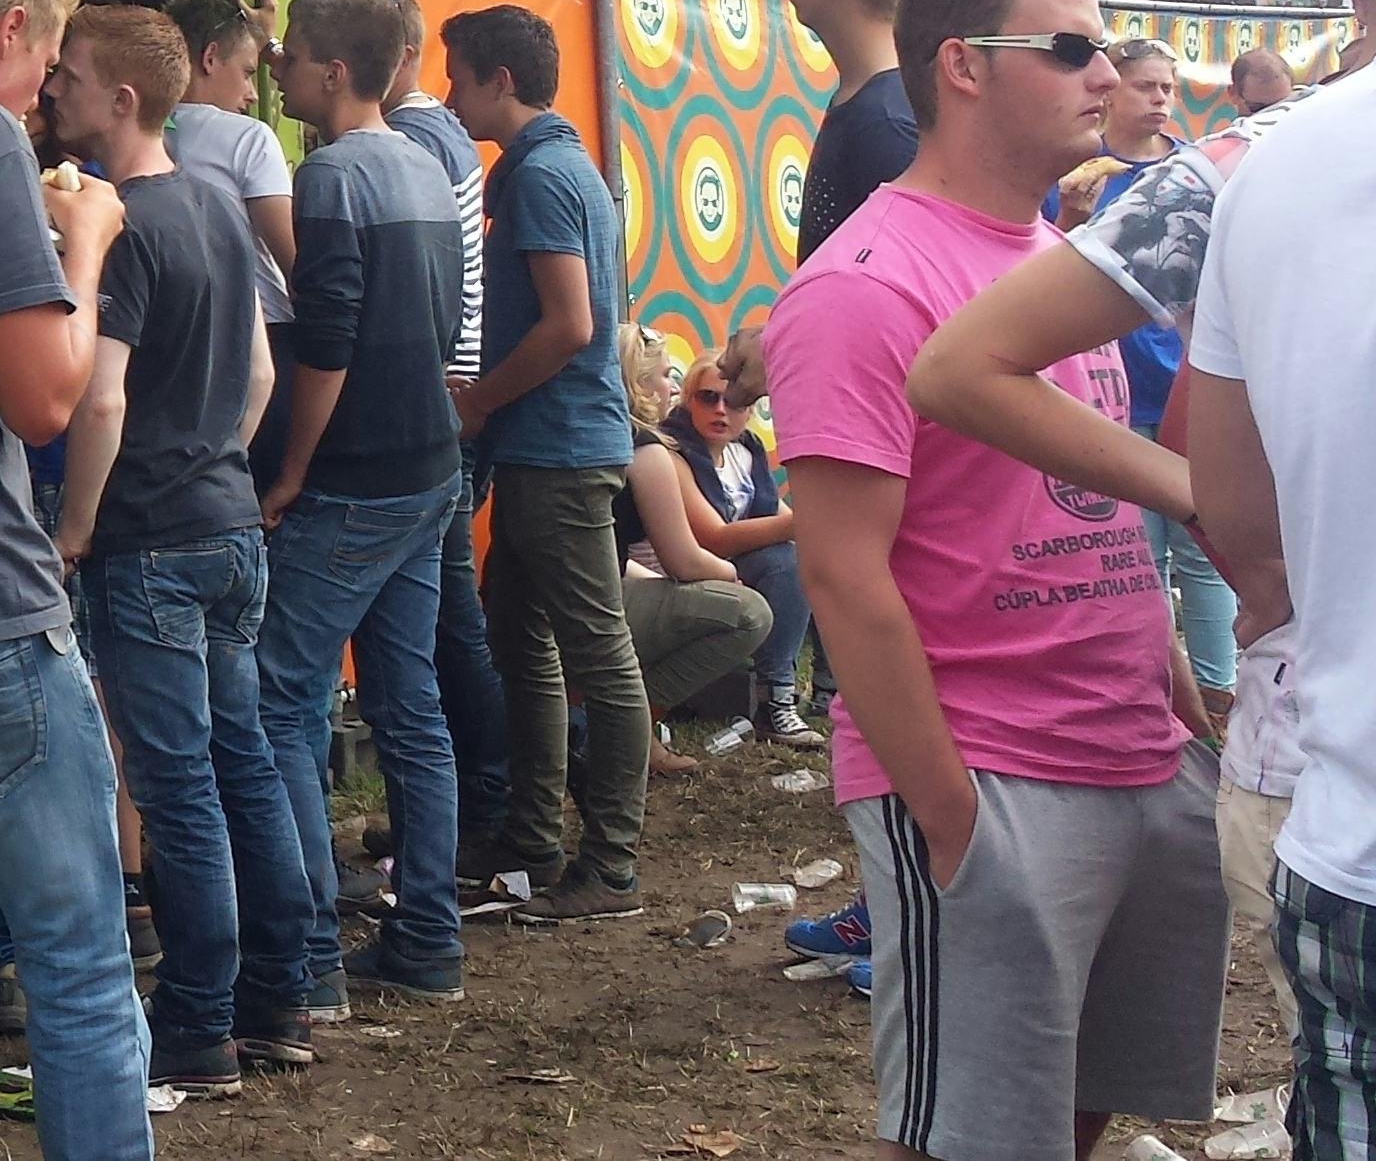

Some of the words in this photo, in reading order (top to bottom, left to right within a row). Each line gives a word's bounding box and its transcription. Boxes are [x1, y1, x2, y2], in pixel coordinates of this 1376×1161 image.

[1011, 526, 1137, 562] SCARBOROUGH
[1100, 550, 1135, 573] RARE
[992, 586, 1063, 612] CÚPLA
[1063, 577, 1130, 603] BEATHA
